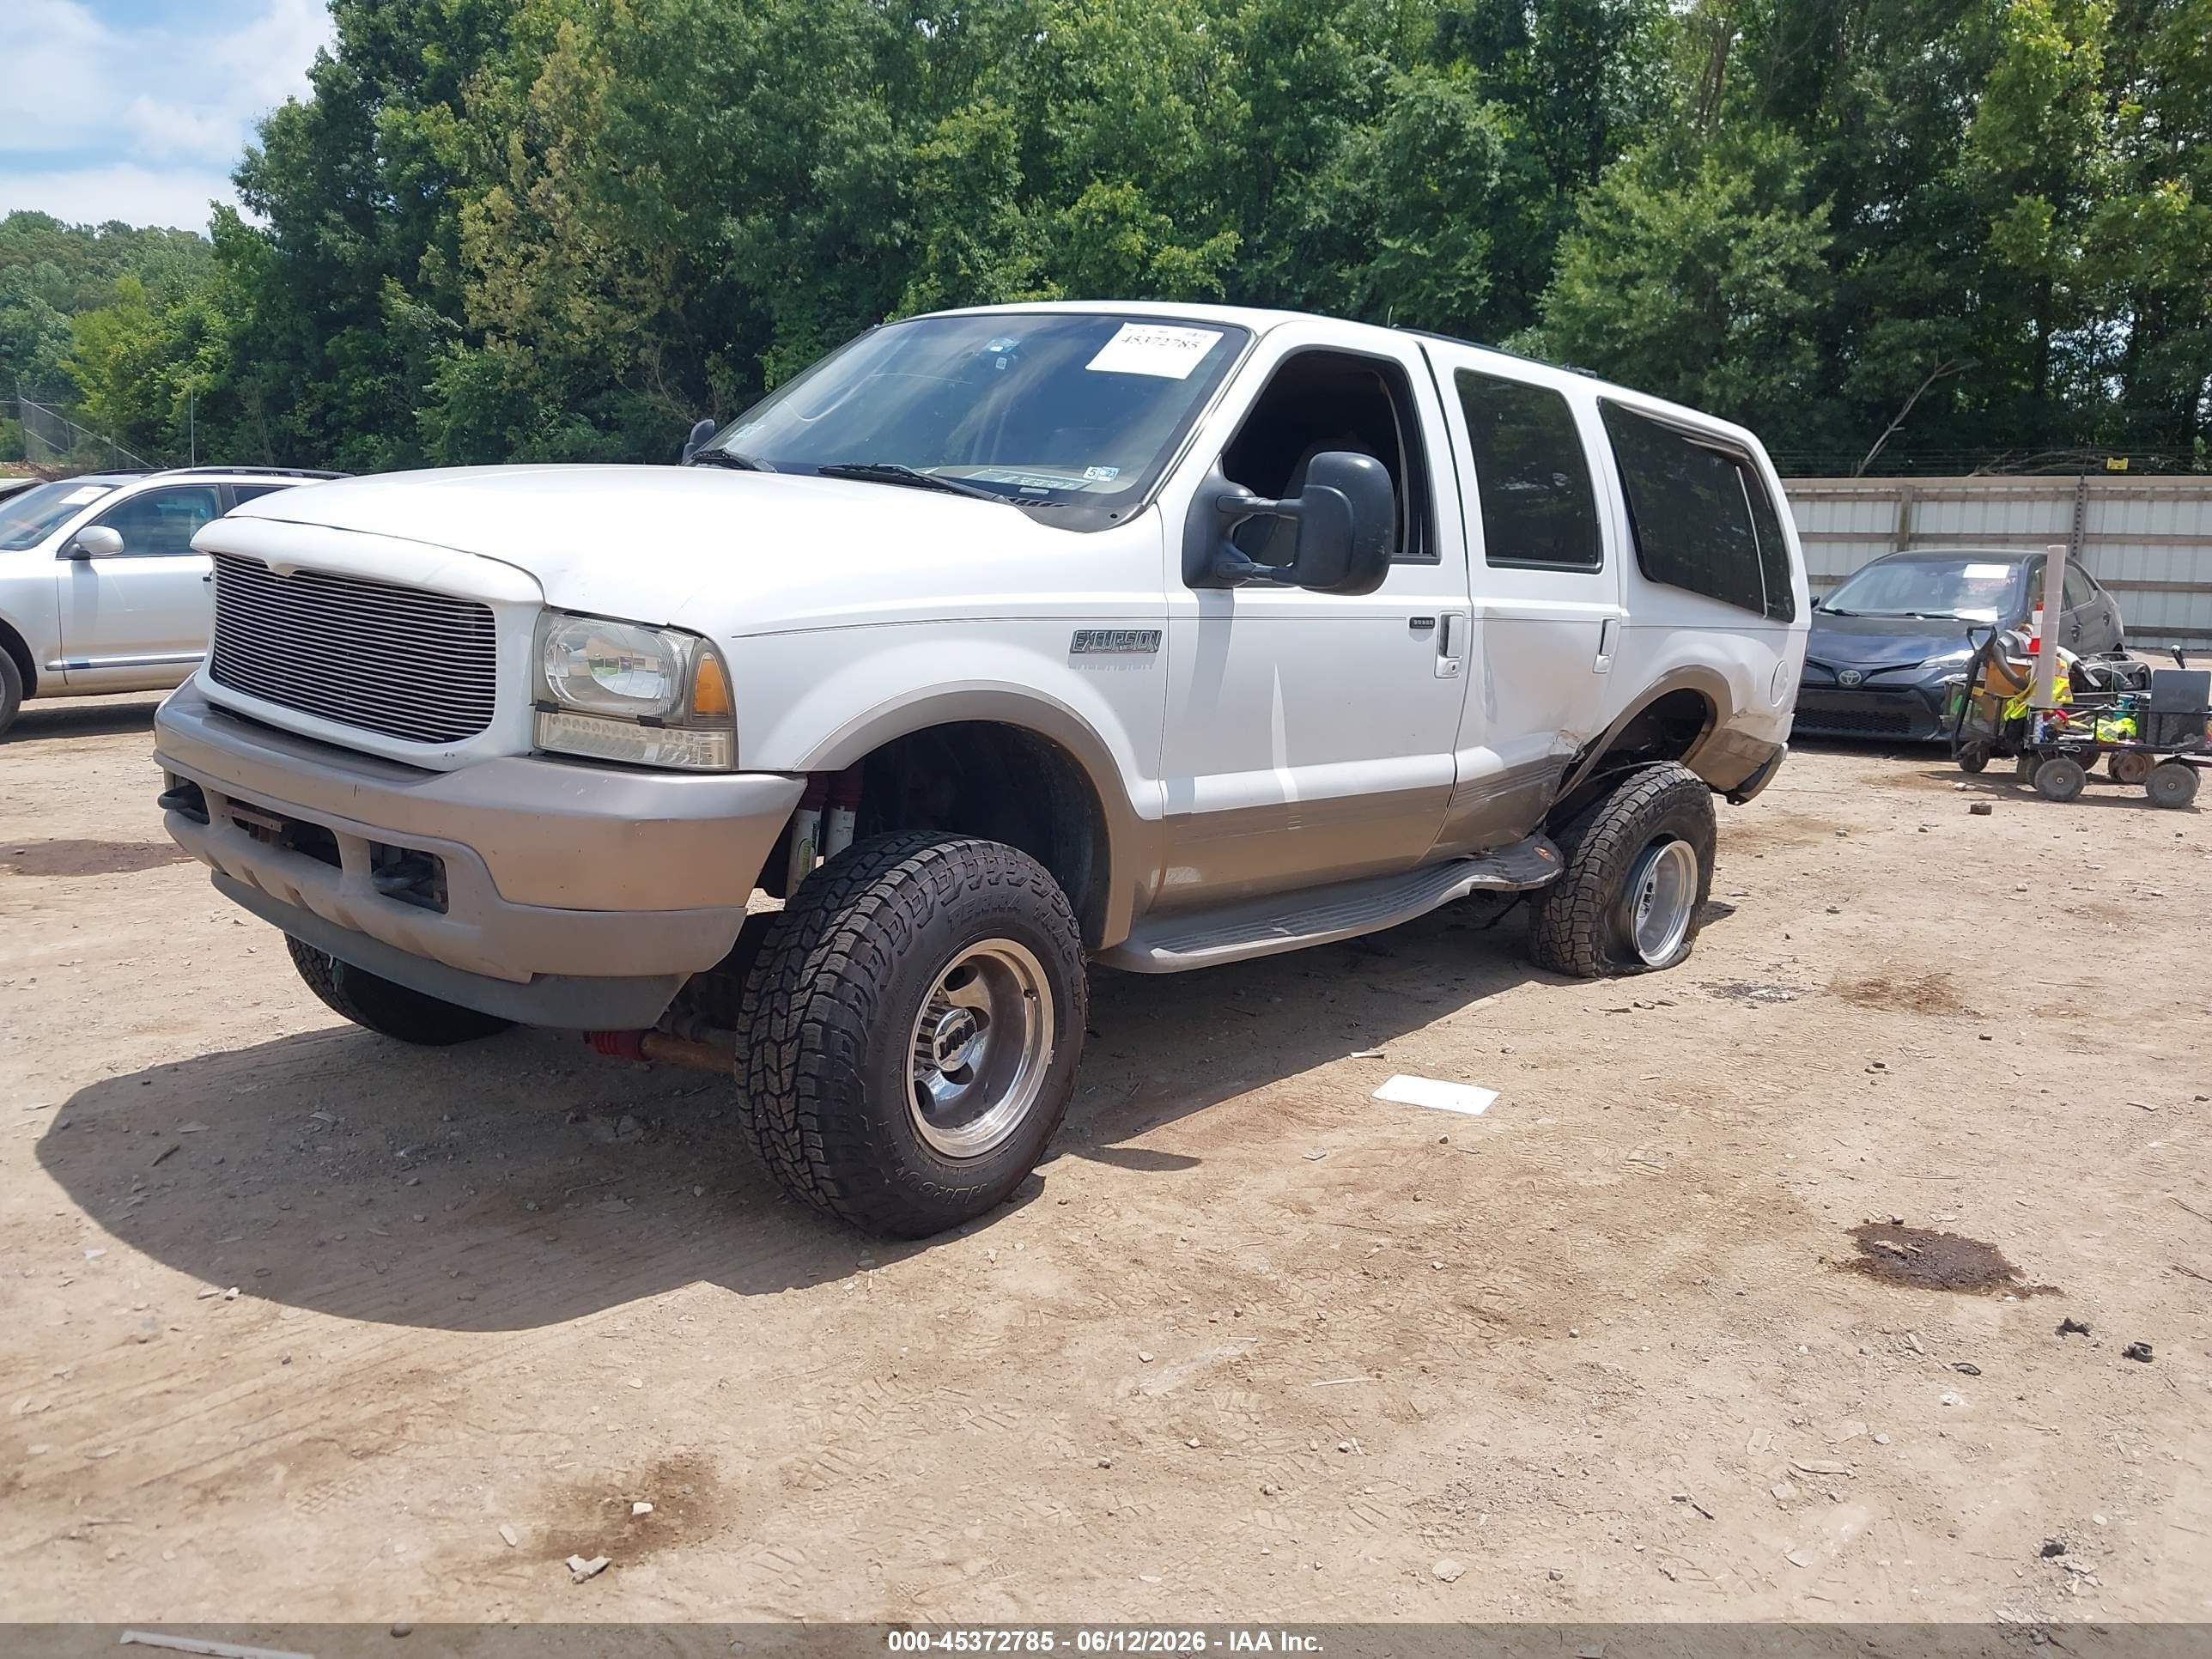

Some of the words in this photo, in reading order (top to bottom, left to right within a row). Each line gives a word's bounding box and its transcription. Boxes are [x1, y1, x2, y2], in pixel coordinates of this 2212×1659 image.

[1121, 336, 1201, 349] 45372785
[1088, 468, 1097, 477] 5
[1072, 630, 1160, 652] EXCURSION
[948, 893, 1021, 932] TERRA
[1033, 902, 1075, 966] TRAC
